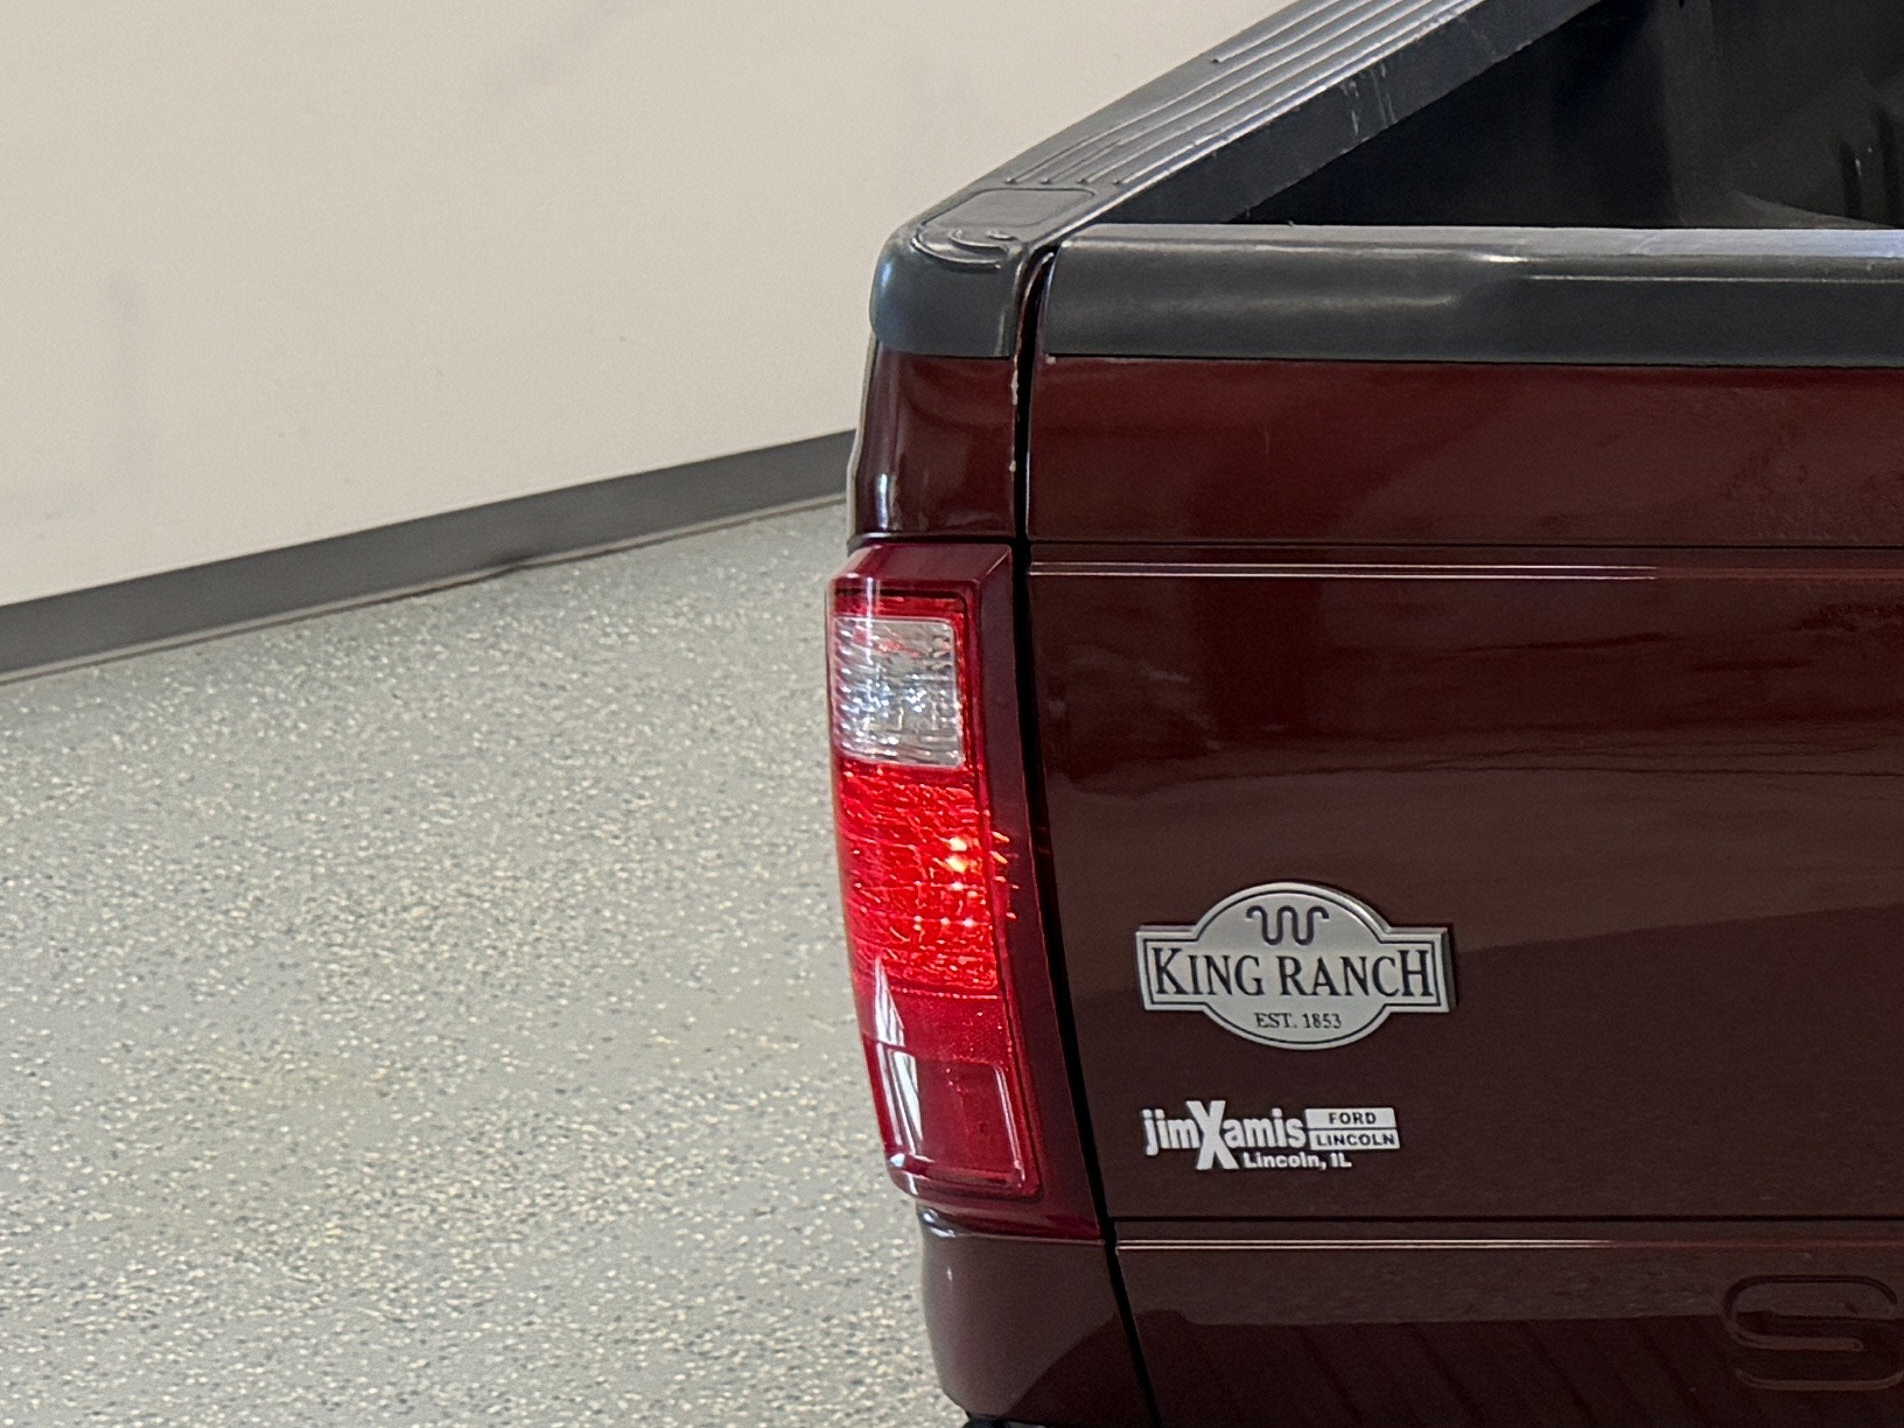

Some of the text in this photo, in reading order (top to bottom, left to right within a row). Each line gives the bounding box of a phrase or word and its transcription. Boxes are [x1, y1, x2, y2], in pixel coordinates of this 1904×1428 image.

[1151, 947, 1434, 997] KING RANCH
[1254, 1012, 1342, 1029] EST. 1853
[1328, 1112, 1377, 1124] FORD
[1316, 1133, 1396, 1146] LINCOLN
[1243, 1152, 1352, 1170] Lincoln, IL
